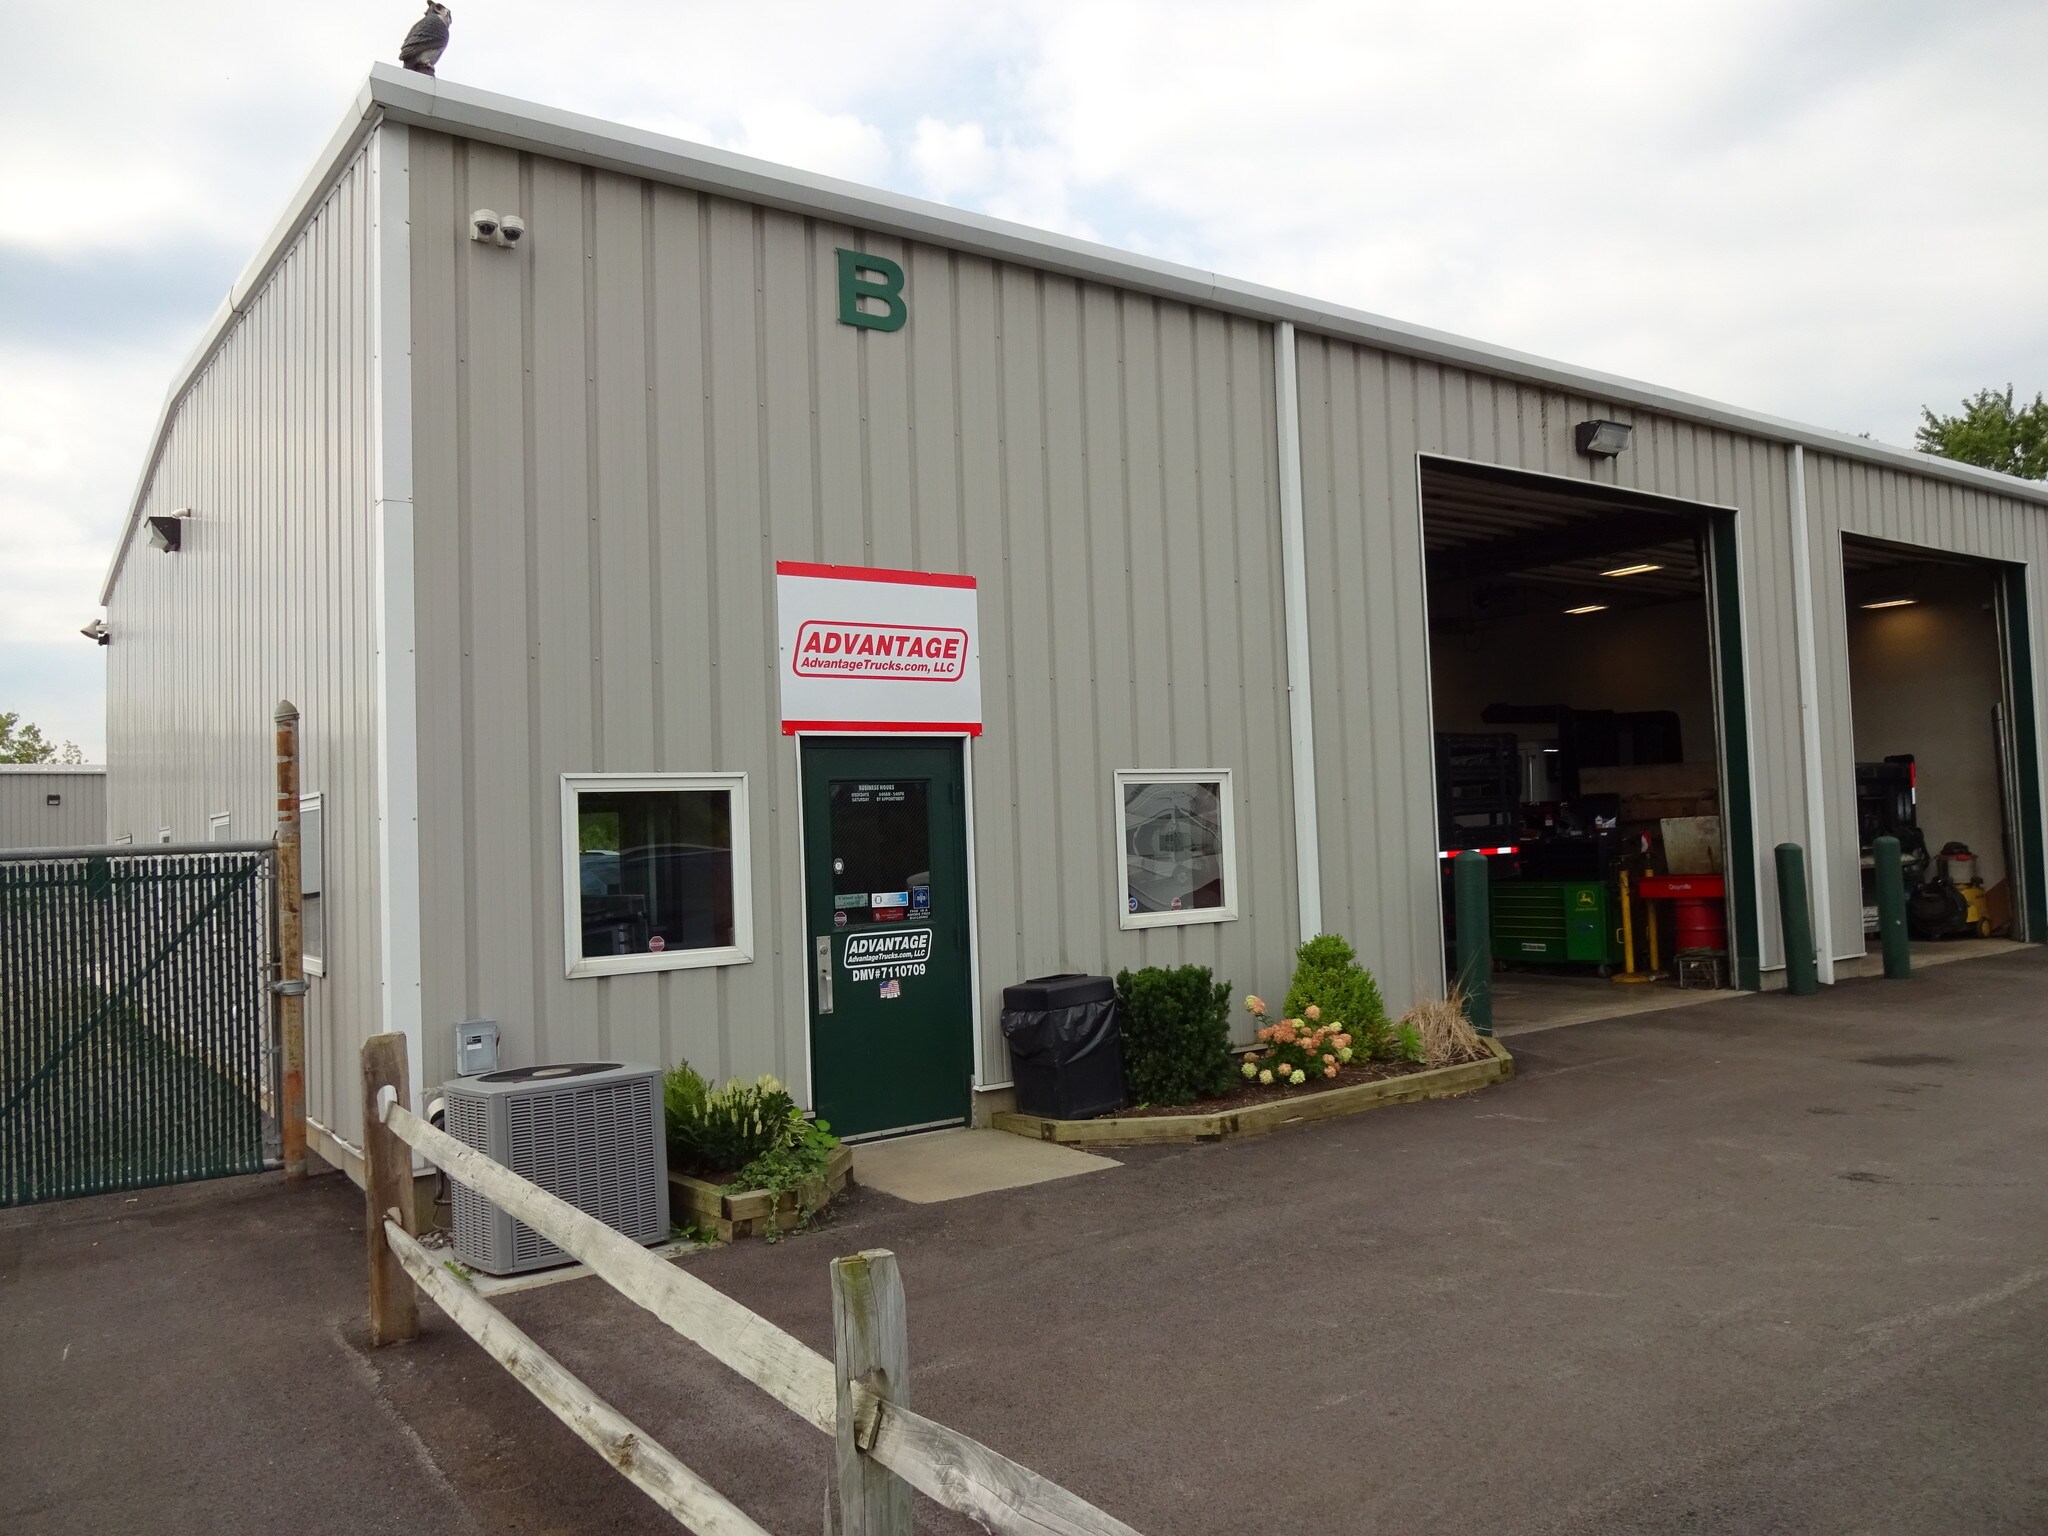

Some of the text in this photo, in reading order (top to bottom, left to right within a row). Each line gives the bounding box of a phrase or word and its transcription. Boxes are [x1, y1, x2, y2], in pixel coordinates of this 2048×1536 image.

[836, 247, 907, 332] B
[803, 631, 960, 659] ADVANTAGE
[801, 657, 954, 674] AdvantageTrucks.com, LLC
[848, 934, 928, 954] ADVANTAGE
[847, 949, 926, 963] AdvantageTrucks.com, LLC
[852, 963, 926, 982] DMV#7110709
